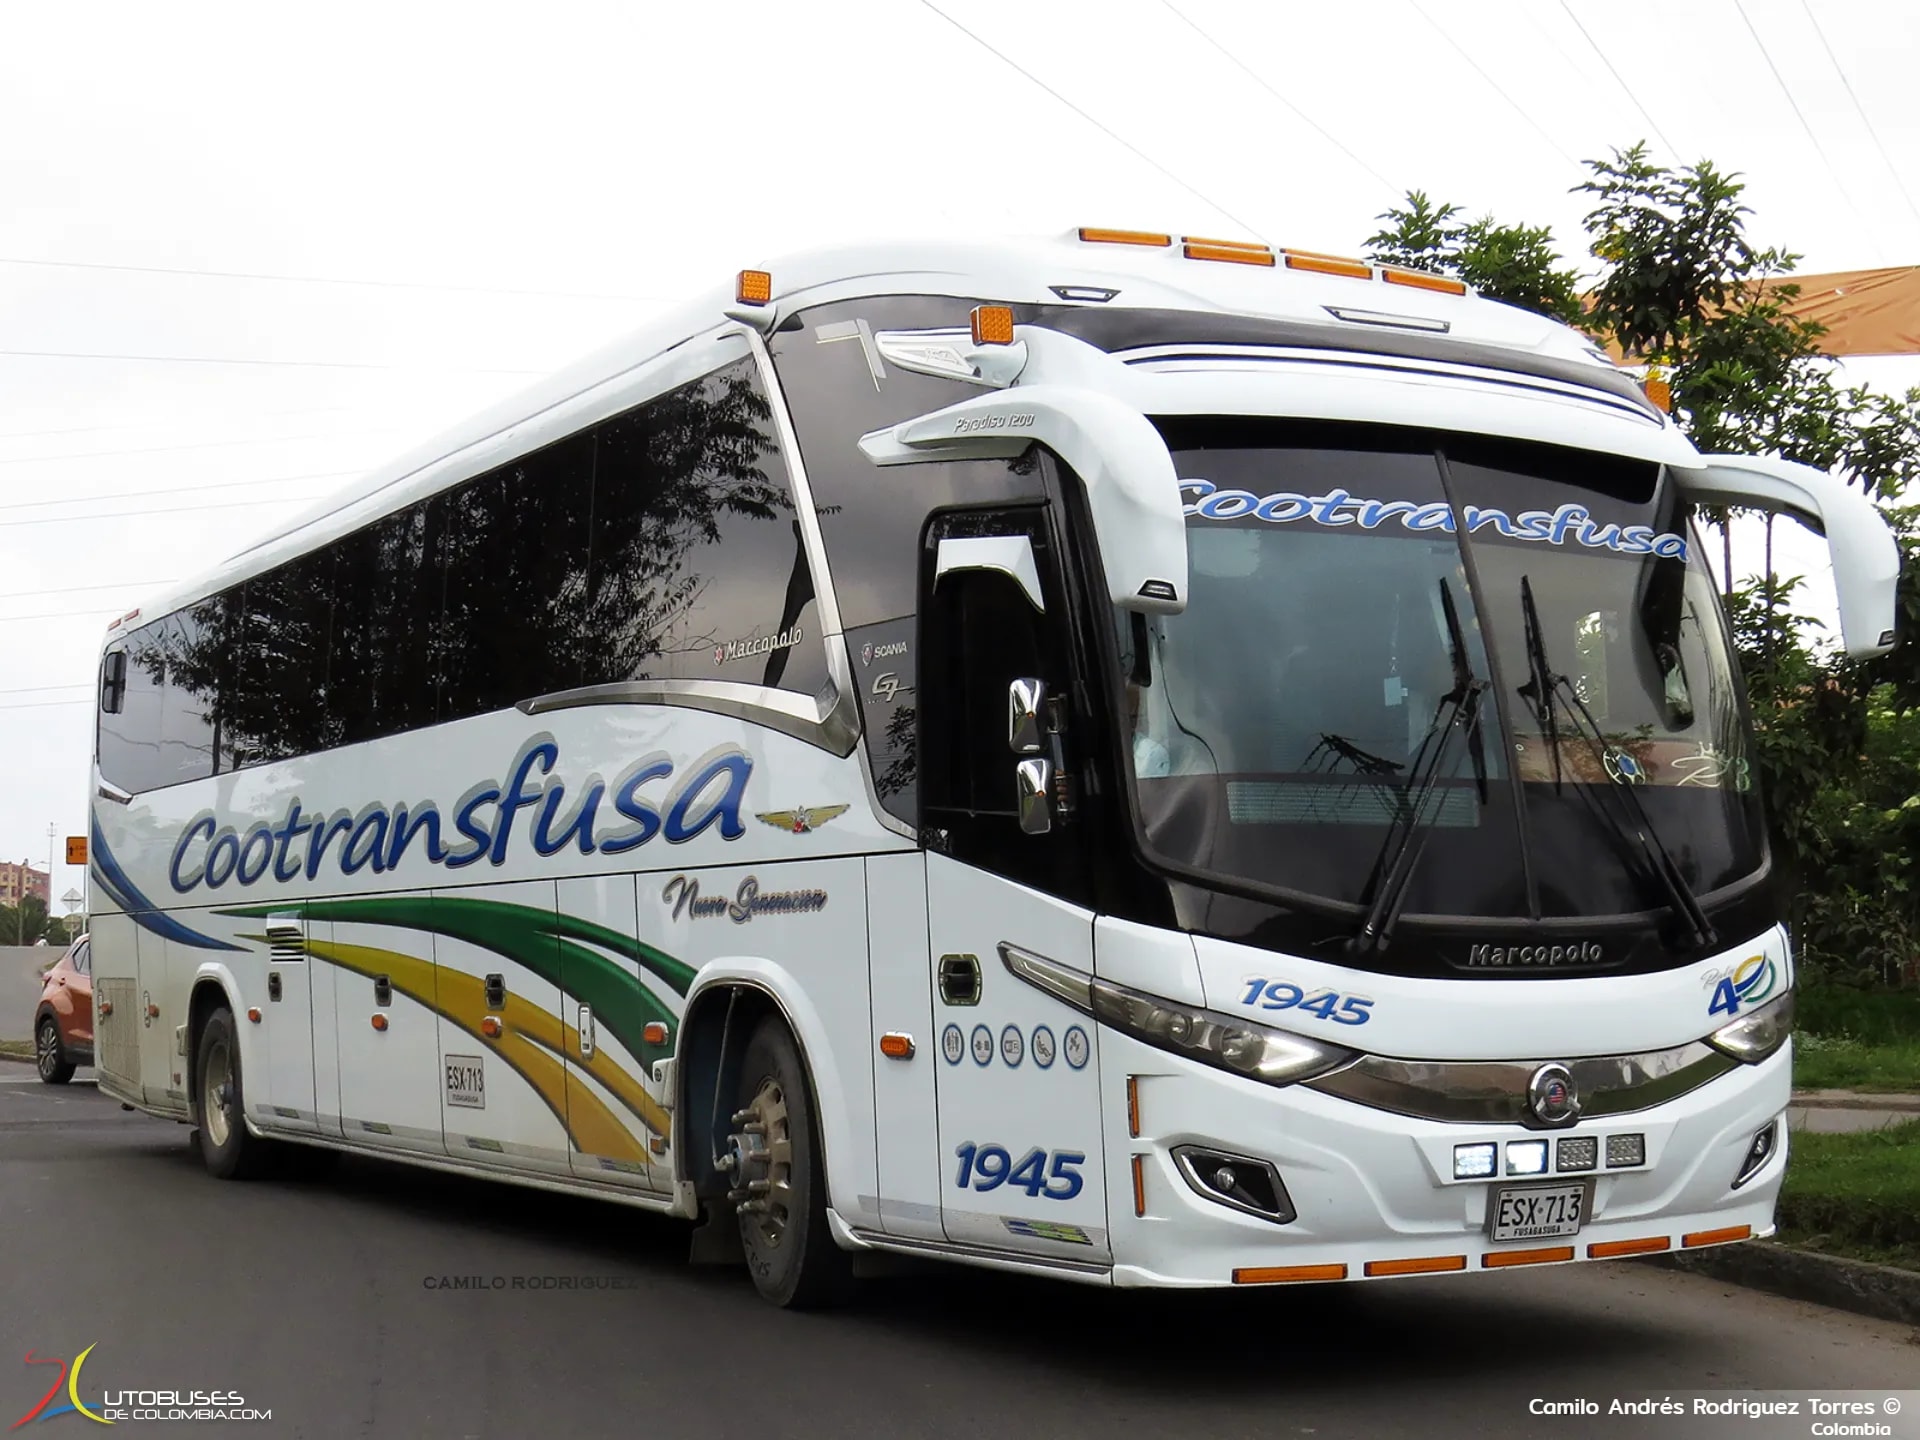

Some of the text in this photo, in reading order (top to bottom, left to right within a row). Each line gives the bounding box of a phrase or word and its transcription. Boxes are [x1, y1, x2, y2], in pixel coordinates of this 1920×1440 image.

[954, 413, 1035, 433] Paradiso 1200
[725, 627, 803, 661] Marcopolo
[874, 641, 907, 658] SCANIA
[169, 731, 753, 894] Cootransfusa
[1468, 941, 1603, 966] Marcopolo
[1240, 977, 1375, 1026] 1945
[954, 1141, 1086, 1200] 1945
[1513, 1224, 1561, 1237] FUSAGASUGA
